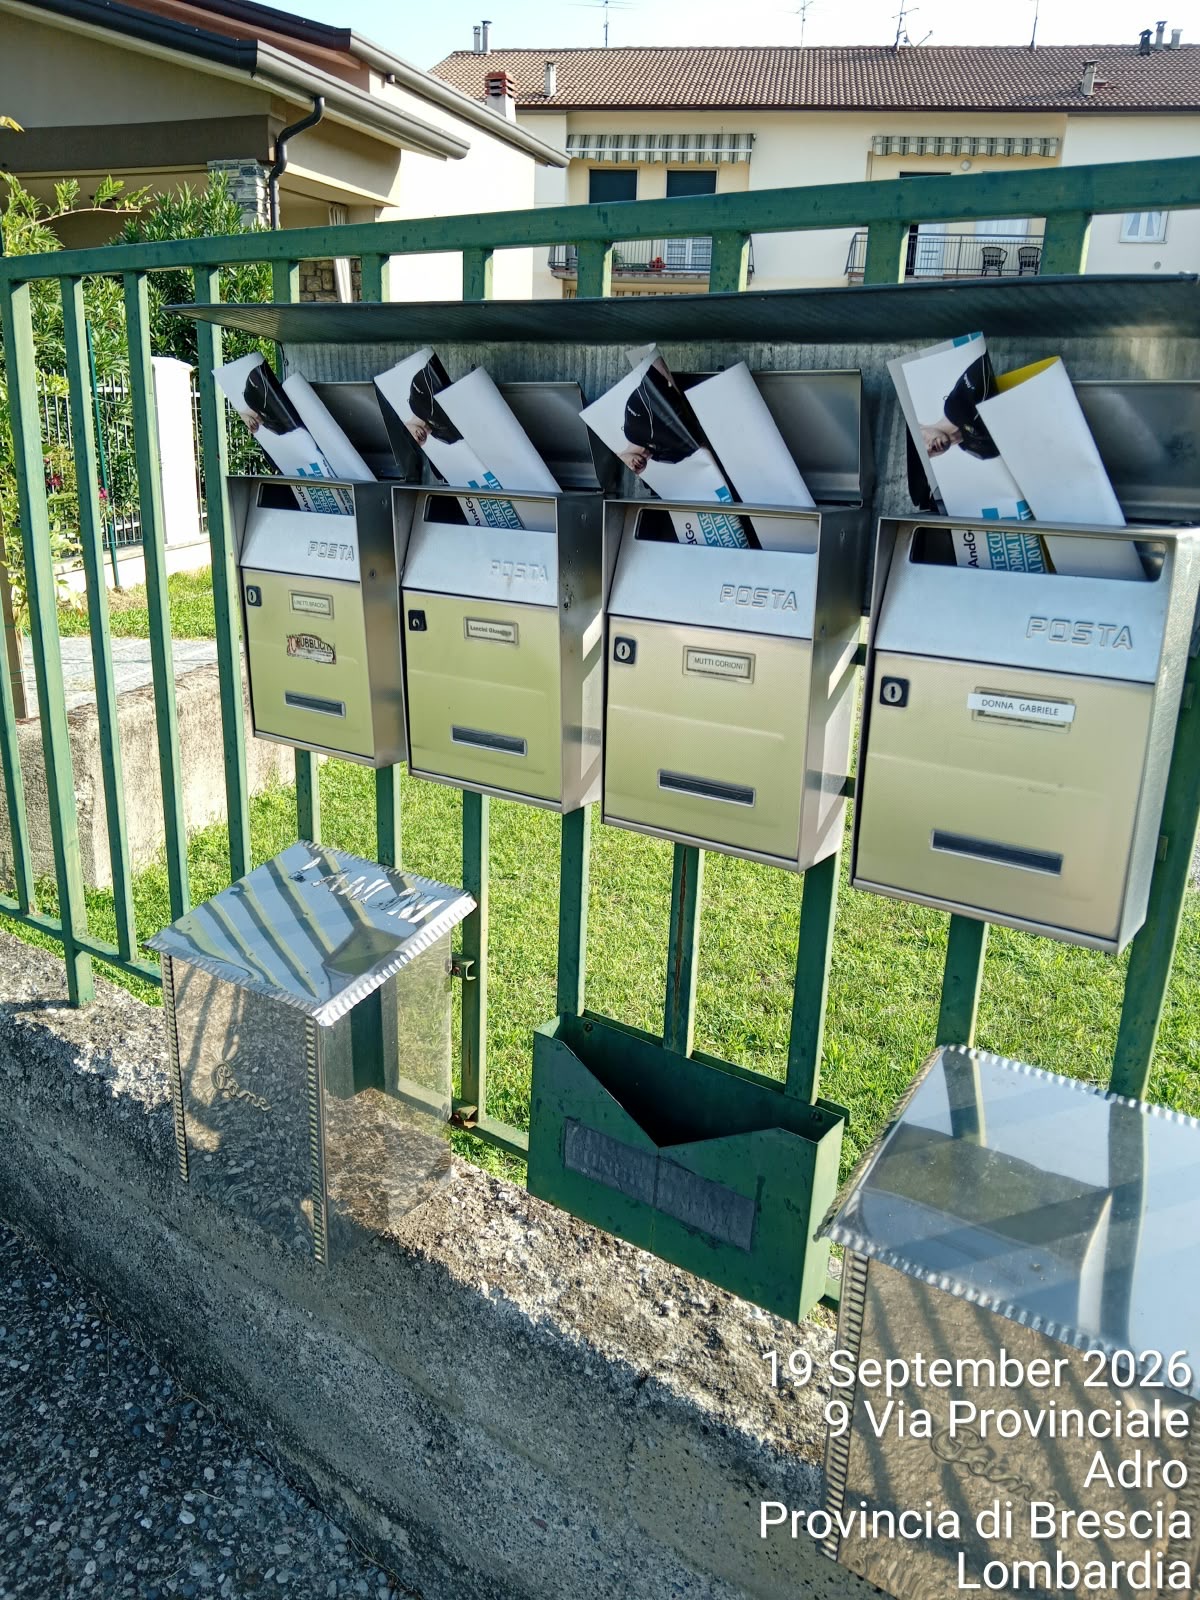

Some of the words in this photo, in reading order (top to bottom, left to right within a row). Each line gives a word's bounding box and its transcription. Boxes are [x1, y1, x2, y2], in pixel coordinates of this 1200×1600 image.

[308, 540, 355, 562] POSTA
[1006, 541, 1024, 572] ORMA
[1027, 549, 1041, 561] 20
[489, 559, 549, 584] POSTA
[720, 583, 798, 611] POSTA
[1026, 616, 1133, 649] POSTA
[694, 656, 714, 666] MUTTI
[714, 659, 744, 670] CORIONI
[981, 698, 1014, 711] DONNA
[1019, 703, 1060, 716] GABRIELE
